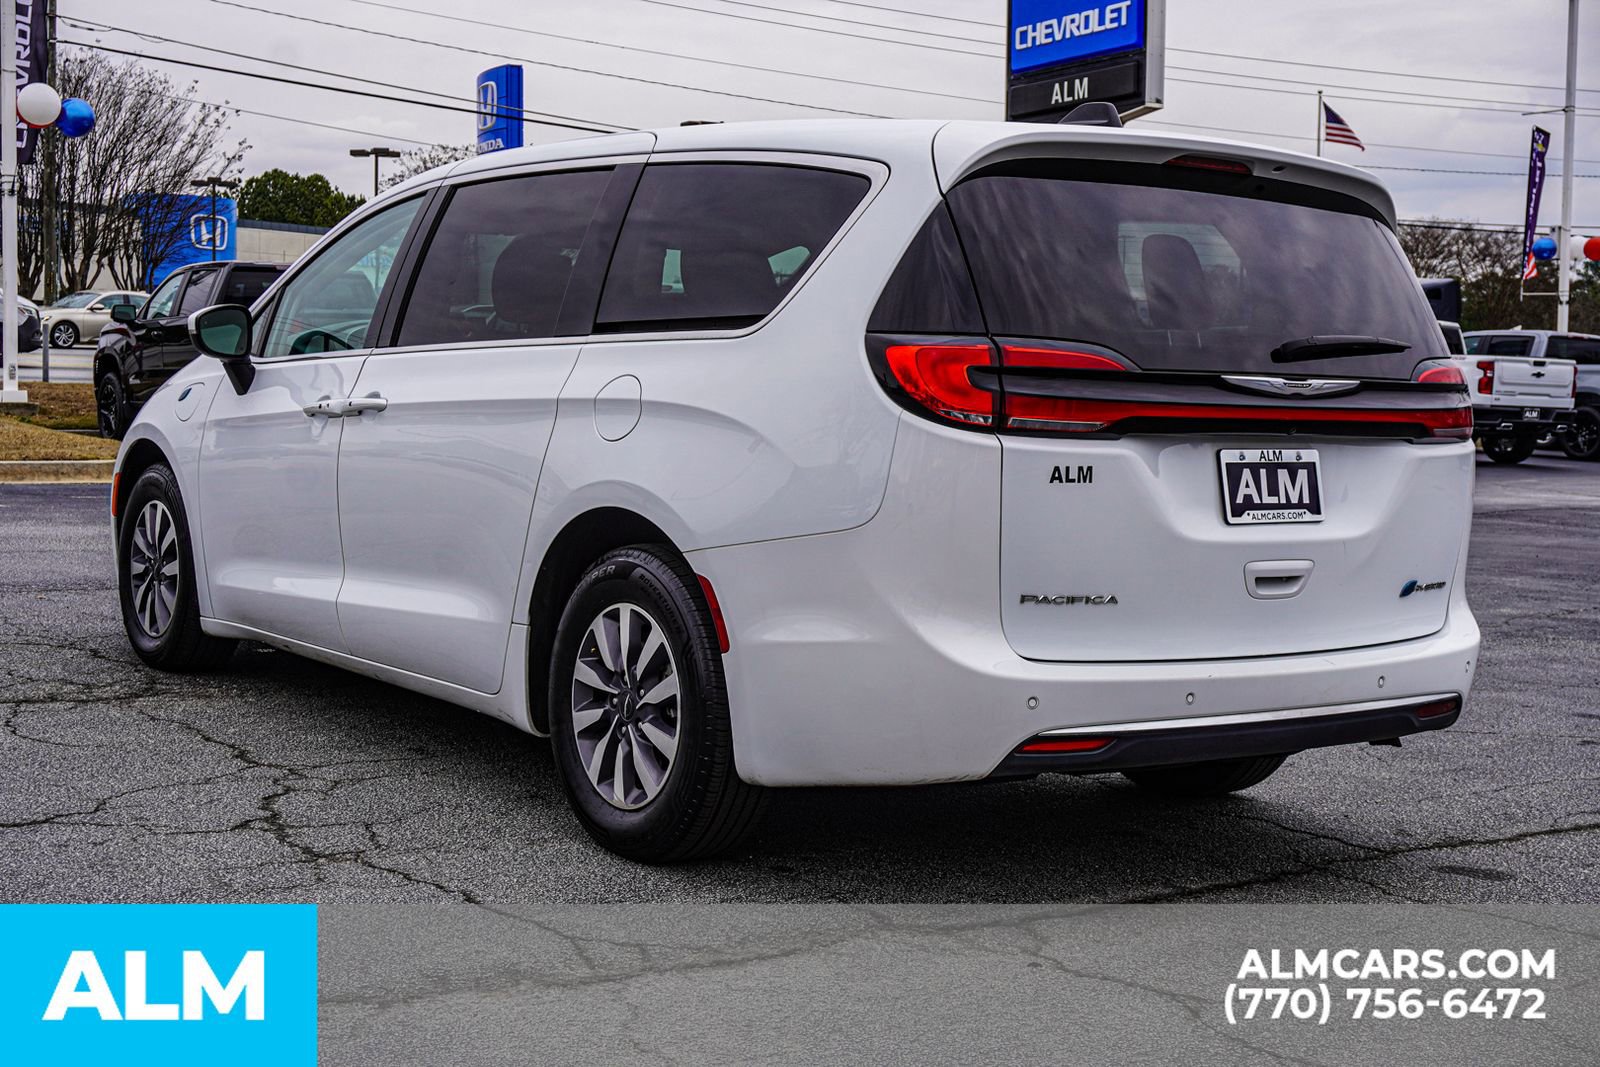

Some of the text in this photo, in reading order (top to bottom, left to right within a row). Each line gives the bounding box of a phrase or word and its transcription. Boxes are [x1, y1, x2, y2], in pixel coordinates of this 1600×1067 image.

[1015, 1, 1131, 50] CHEVROLET
[1051, 77, 1088, 104] ALM
[477, 138, 505, 154] ONDA
[1259, 450, 1282, 461] ALM
[1049, 466, 1093, 483] ALM
[1236, 468, 1310, 504] ALM
[1251, 512, 1304, 521] ALMCARS.COM
[1019, 594, 1118, 605] PACIFICA
